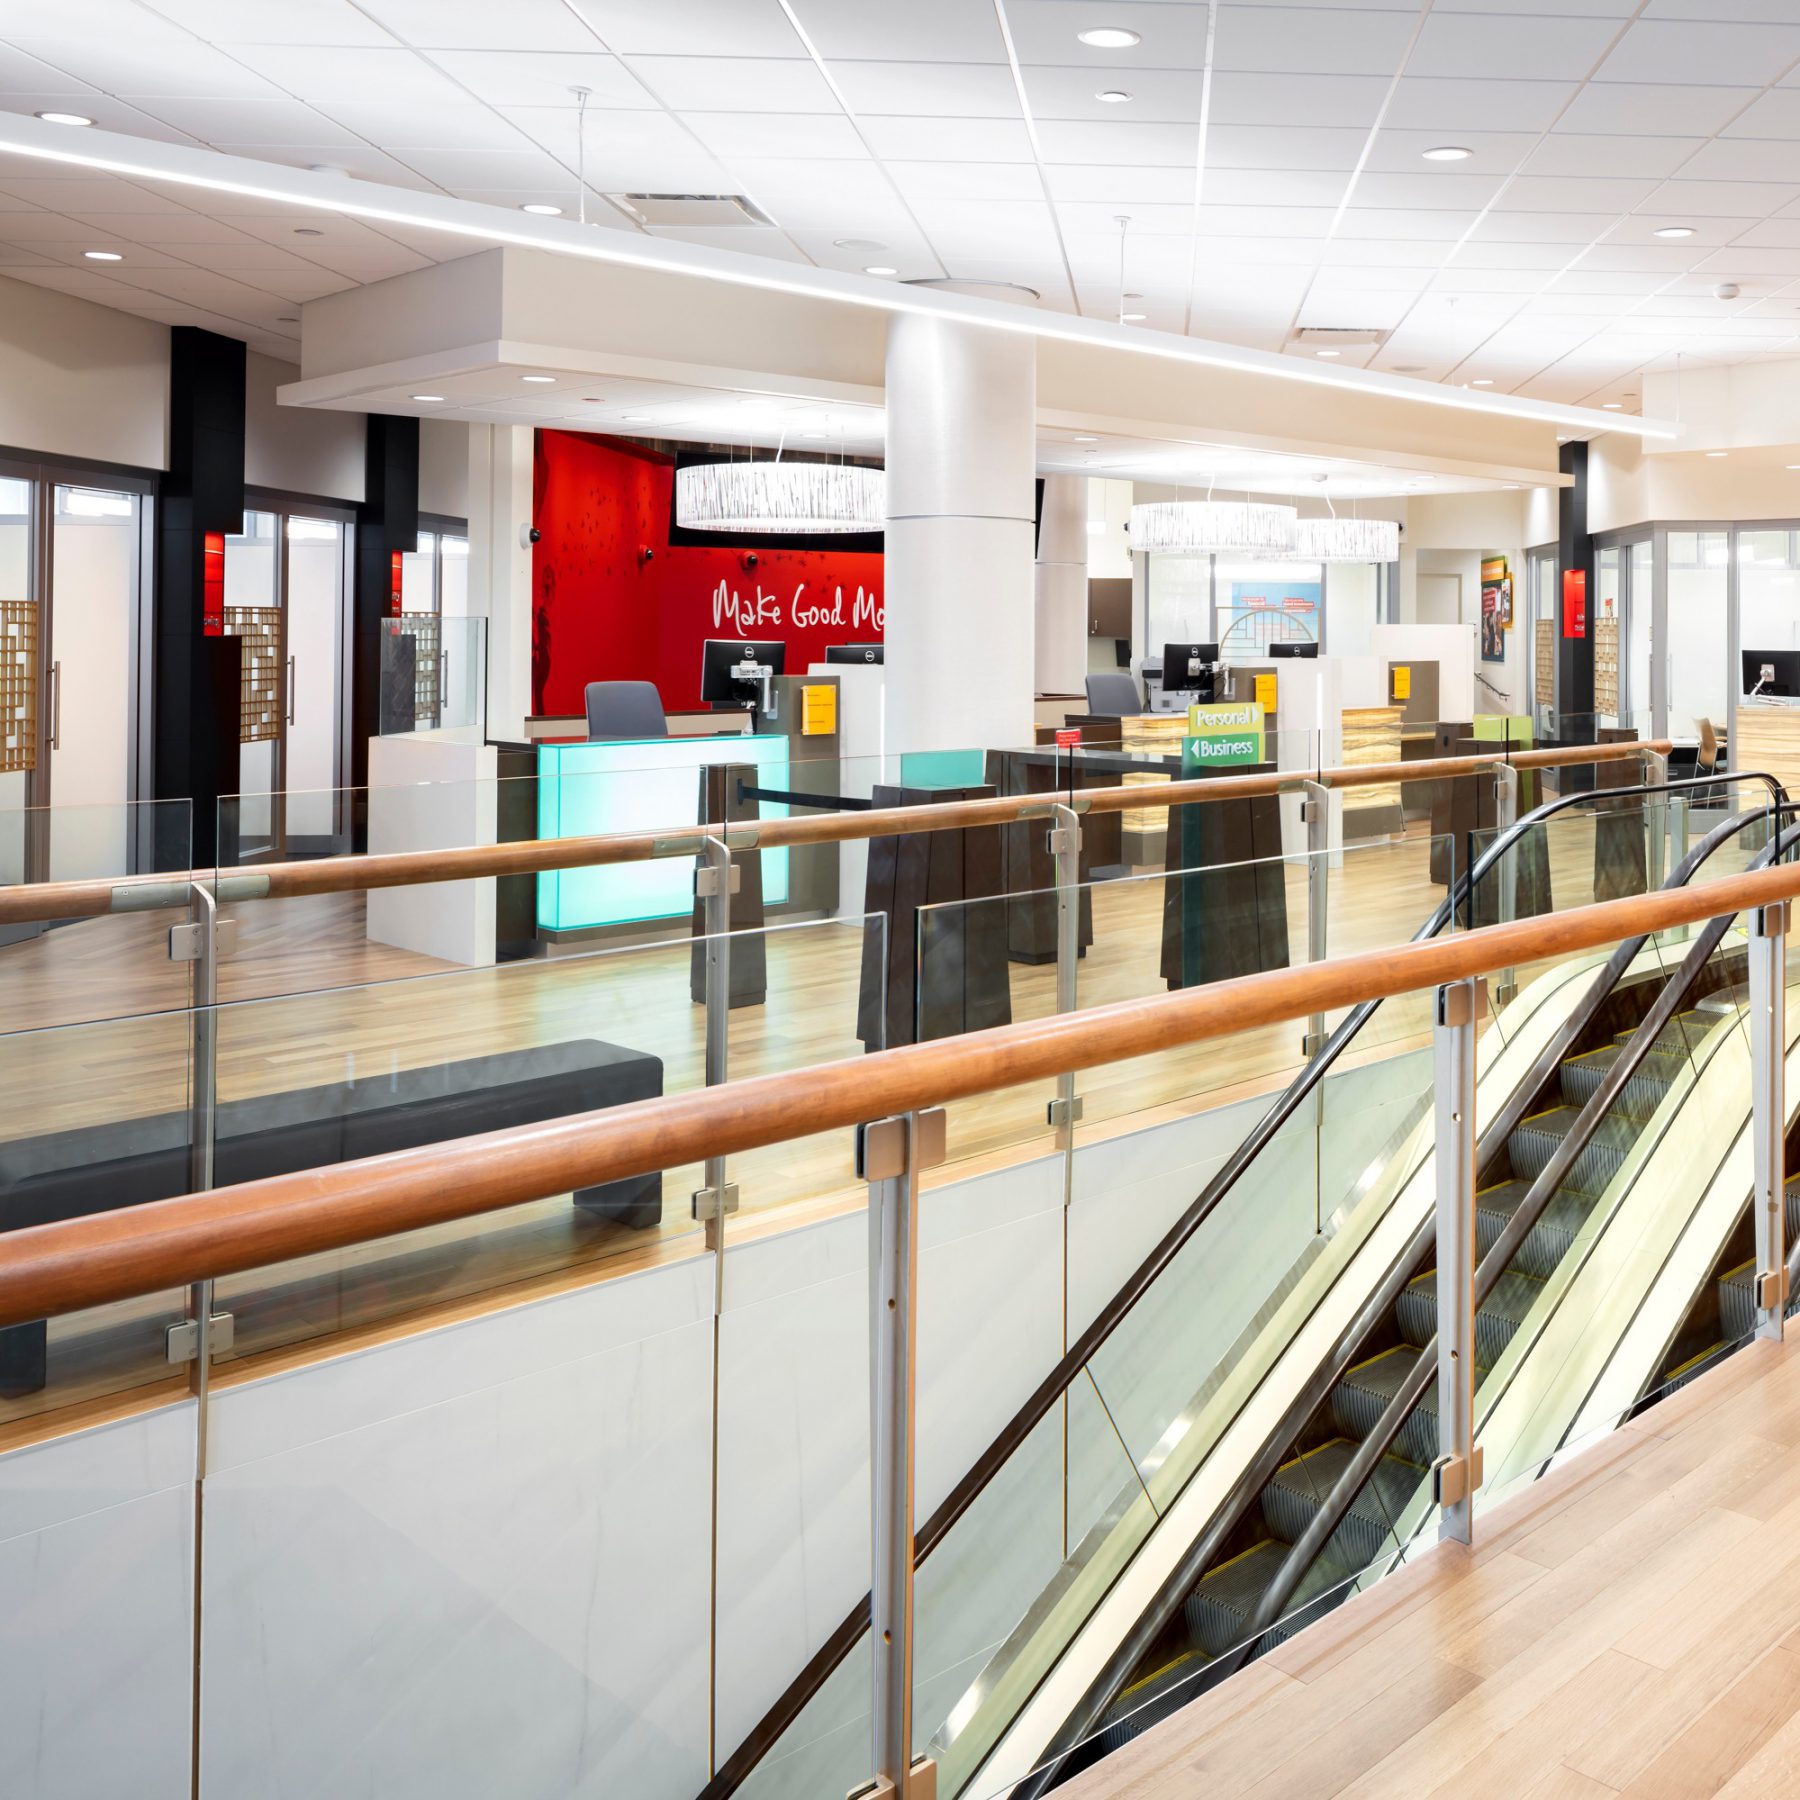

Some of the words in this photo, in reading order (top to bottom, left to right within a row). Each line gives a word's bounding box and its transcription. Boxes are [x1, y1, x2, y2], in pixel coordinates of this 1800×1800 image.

[713, 579, 782, 636] Make
[791, 583, 847, 628] Good
[1196, 708, 1249, 726] Personal
[1201, 740, 1254, 757] Business
